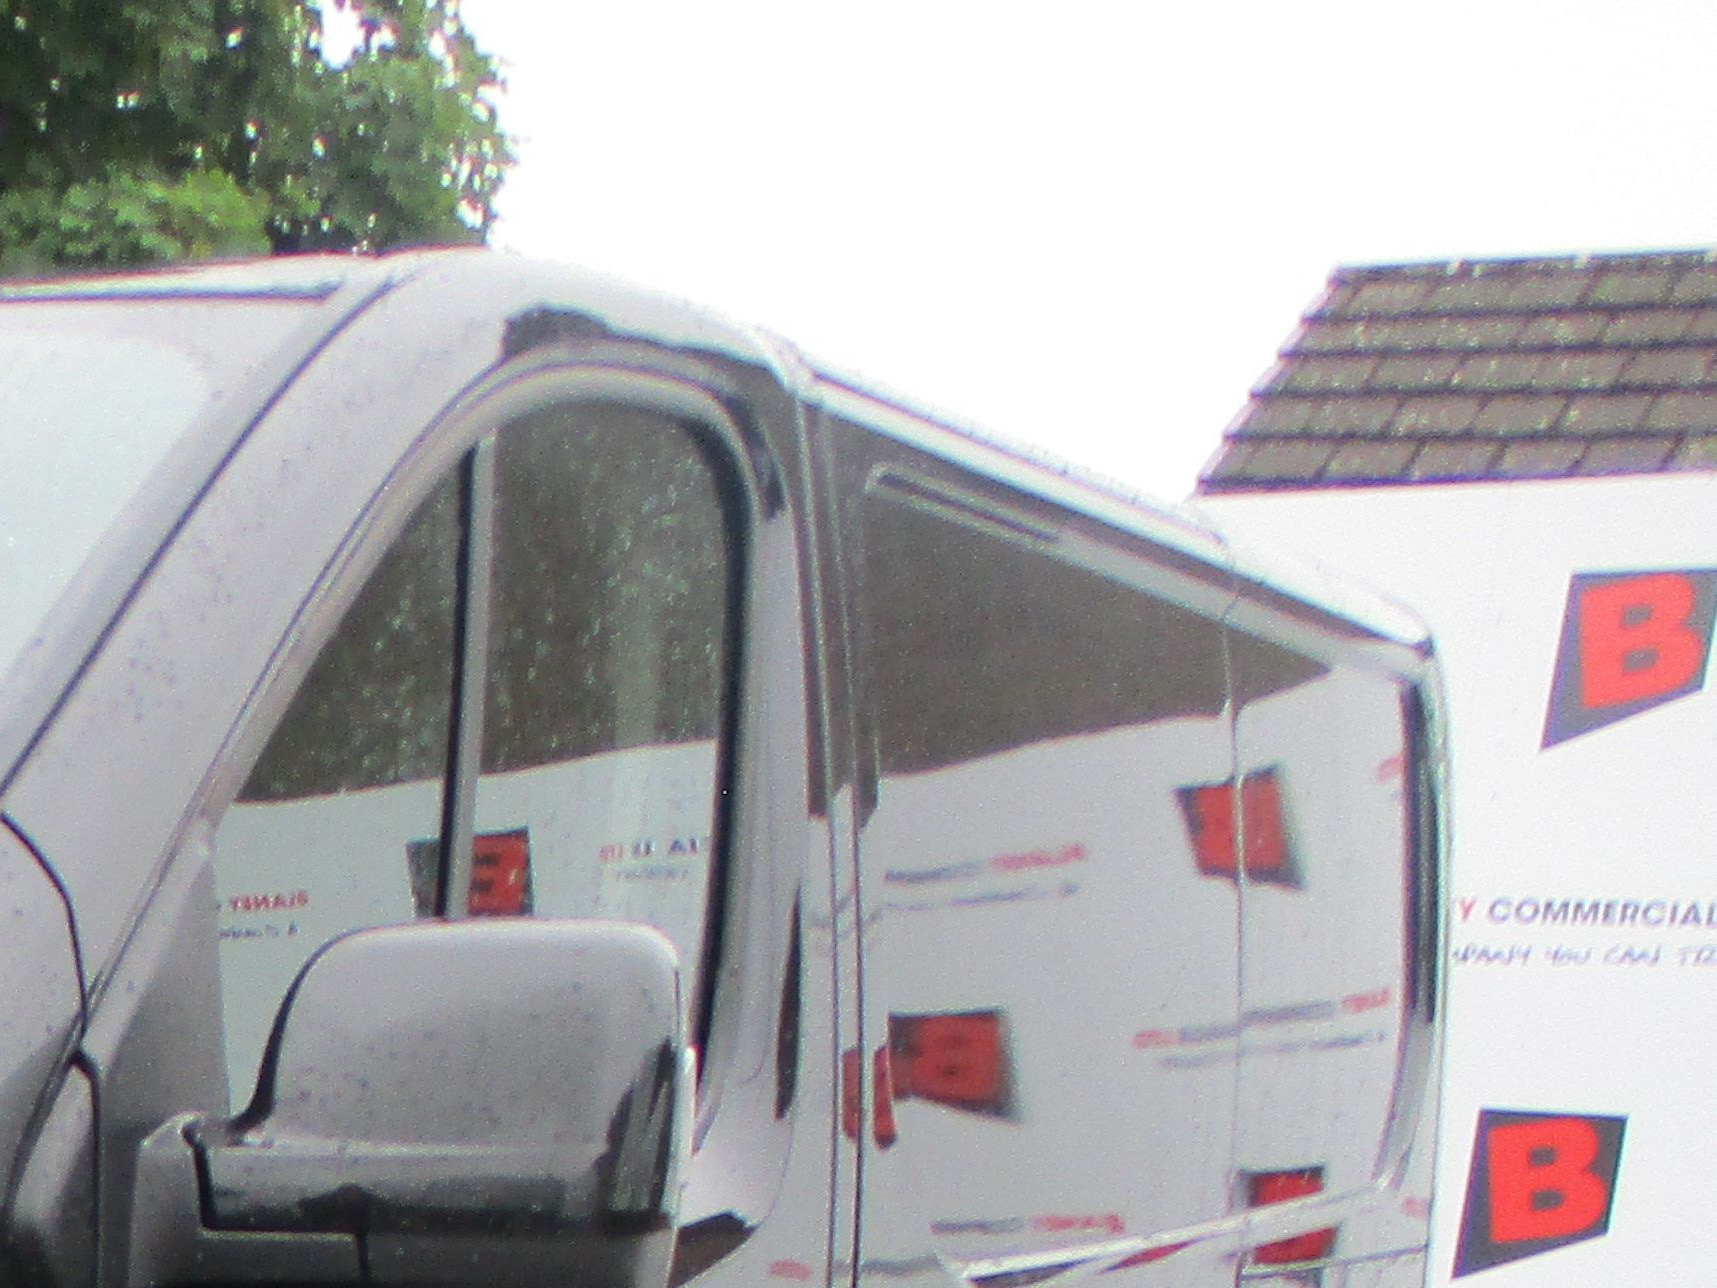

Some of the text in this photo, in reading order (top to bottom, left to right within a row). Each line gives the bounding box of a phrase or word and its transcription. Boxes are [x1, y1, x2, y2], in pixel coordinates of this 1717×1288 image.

[1578, 573, 1703, 711] B
[1603, 943, 1662, 966] CAN
[1488, 1117, 1607, 1243] B
